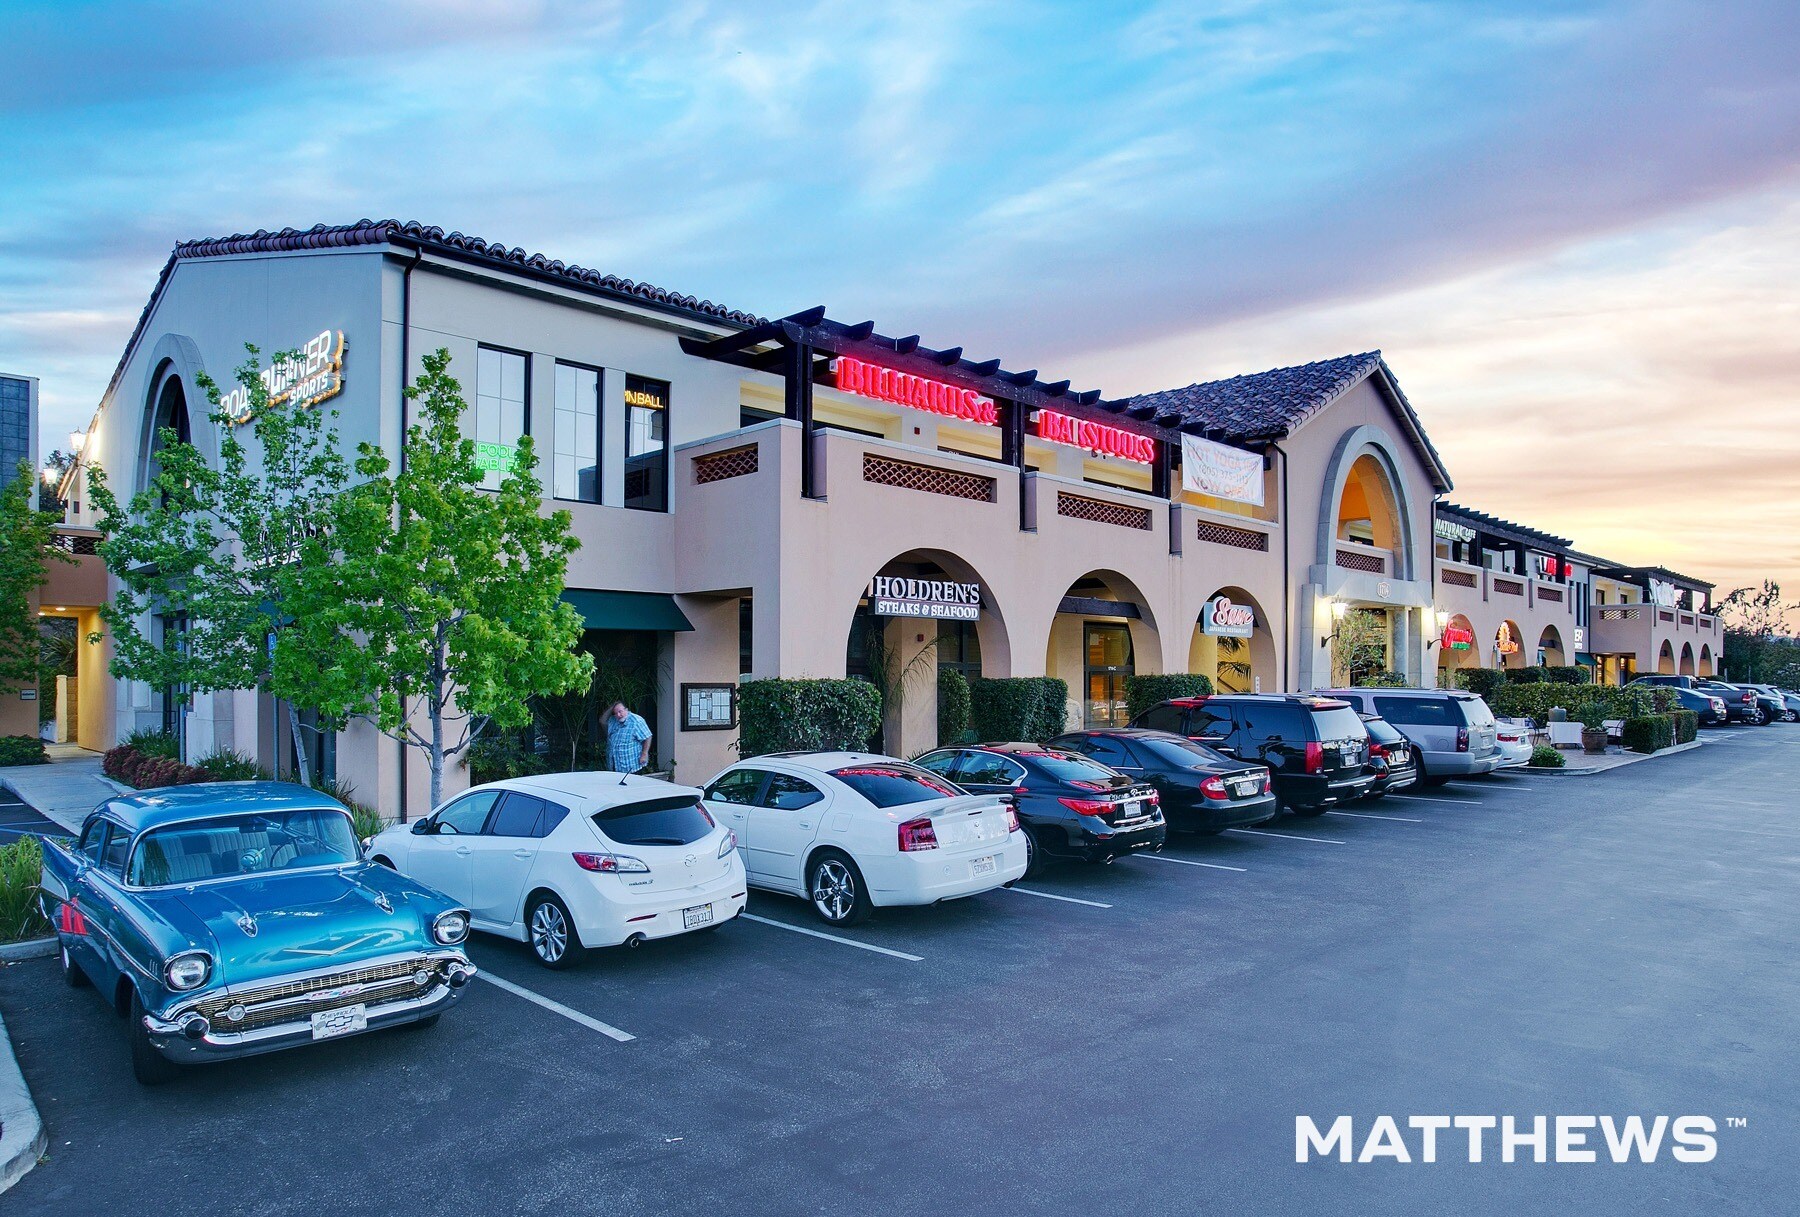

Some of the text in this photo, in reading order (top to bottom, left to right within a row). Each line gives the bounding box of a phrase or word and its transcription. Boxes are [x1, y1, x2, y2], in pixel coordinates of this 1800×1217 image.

[289, 369, 328, 407] SPORTS
[837, 356, 978, 422] BILLIARDS
[477, 443, 517, 459] POOL
[1039, 409, 1154, 465] BARSTOOLS
[874, 575, 980, 604] HOLDREN'S
[878, 600, 978, 619] STEAKS & SEAFOOD
